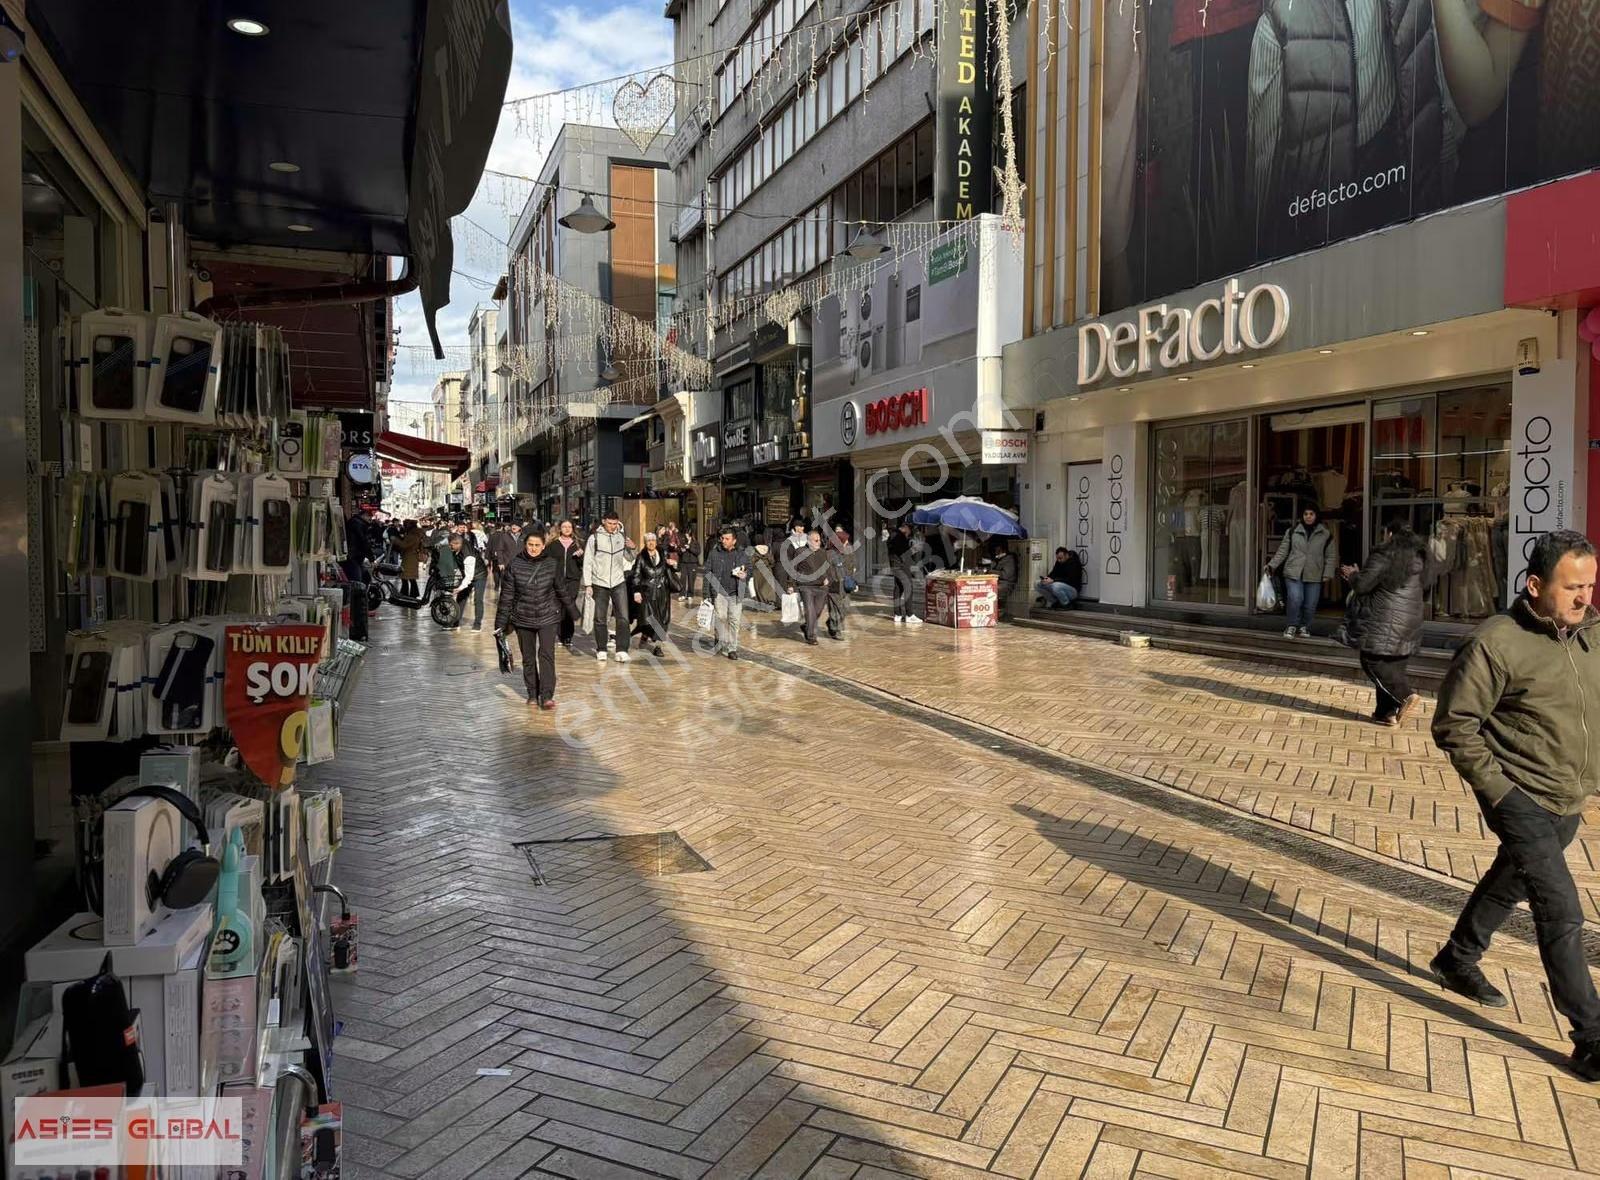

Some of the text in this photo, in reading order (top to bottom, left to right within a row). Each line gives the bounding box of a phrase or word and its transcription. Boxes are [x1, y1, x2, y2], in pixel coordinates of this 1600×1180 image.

[1288, 165, 1406, 218] defacto.com
[1076, 278, 1290, 385] DeFacto
[865, 387, 929, 435] BOSCH
[995, 438, 1027, 448] BOSCH
[1106, 454, 1123, 575] DeFacto
[1556, 480, 1565, 530] defacto.com
[229, 631, 319, 655] TÜM KILIF
